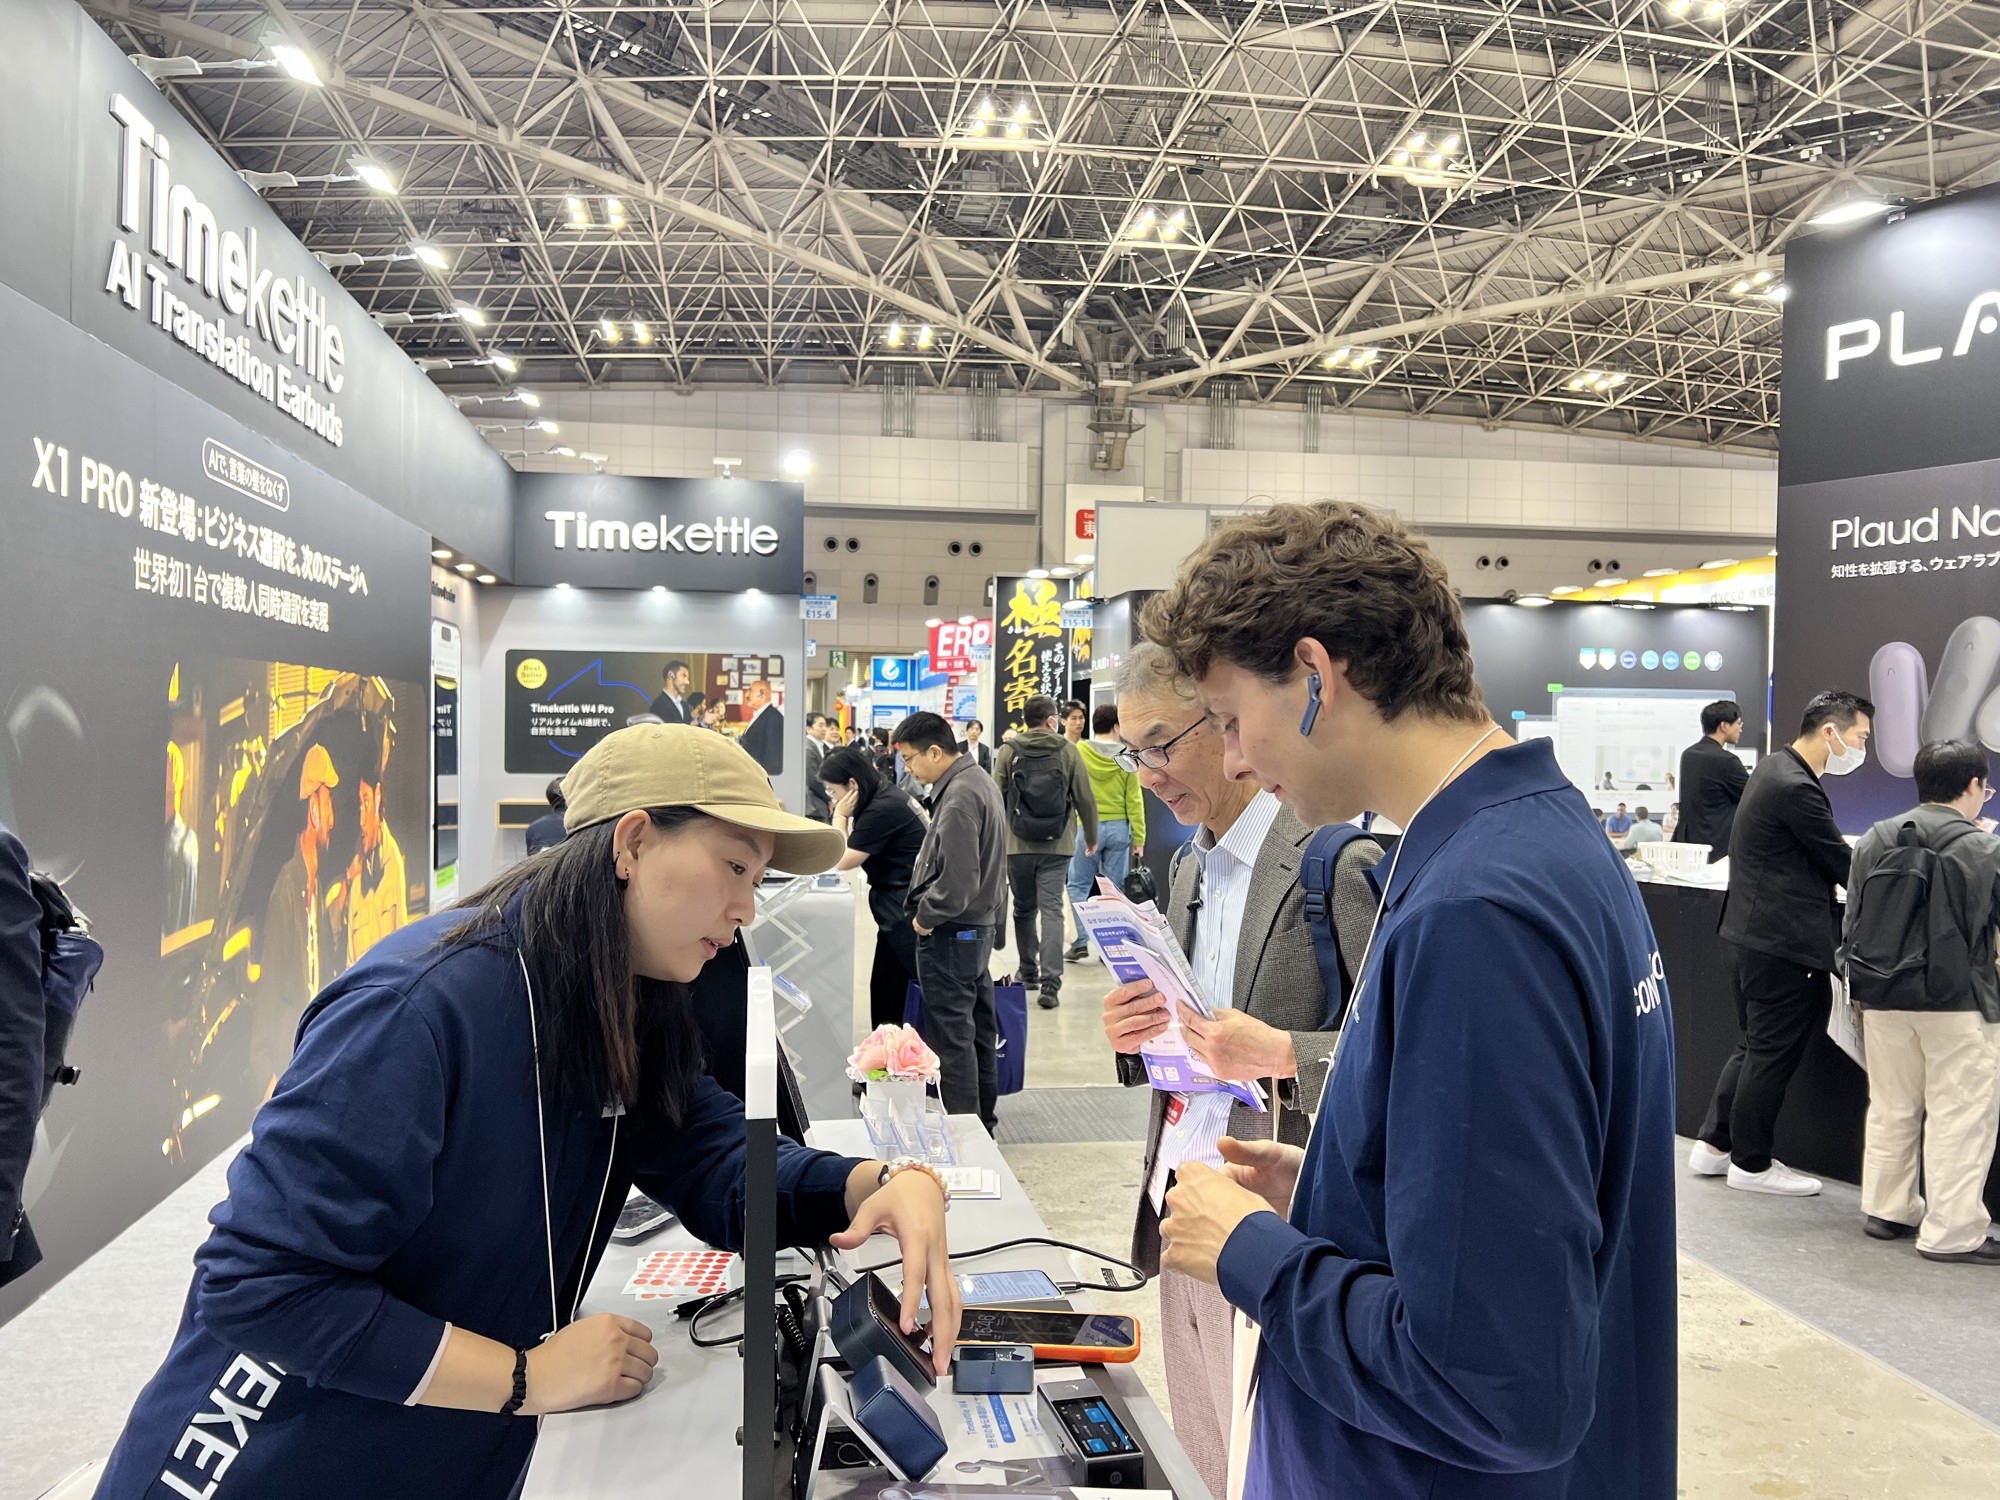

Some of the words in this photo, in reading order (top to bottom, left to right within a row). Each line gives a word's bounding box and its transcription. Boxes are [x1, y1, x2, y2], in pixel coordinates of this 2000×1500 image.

[109, 93, 345, 394] Timekettle
[106, 239, 142, 311] AI
[146, 264, 275, 402] Translation
[276, 363, 344, 448] Earbuds
[32, 436, 69, 497] X1
[81, 456, 134, 518] PRO
[545, 511, 779, 556] Timekettle
[1831, 507, 1939, 551] Plaud
[806, 610, 831, 619] E15-6
[1000, 580, 1062, 638] 極
[1063, 619, 1091, 627] E15-13
[937, 624, 990, 657] ERP
[1003, 638, 1040, 733] 名寄
[1041, 649, 1053, 698] 使える状
[530, 703, 580, 714] Timekettle
[581, 704, 597, 714] W4
[597, 704, 615, 714] Pro
[530, 727, 577, 736] 自然な会話を
[160, 1353, 287, 1500] EKET
